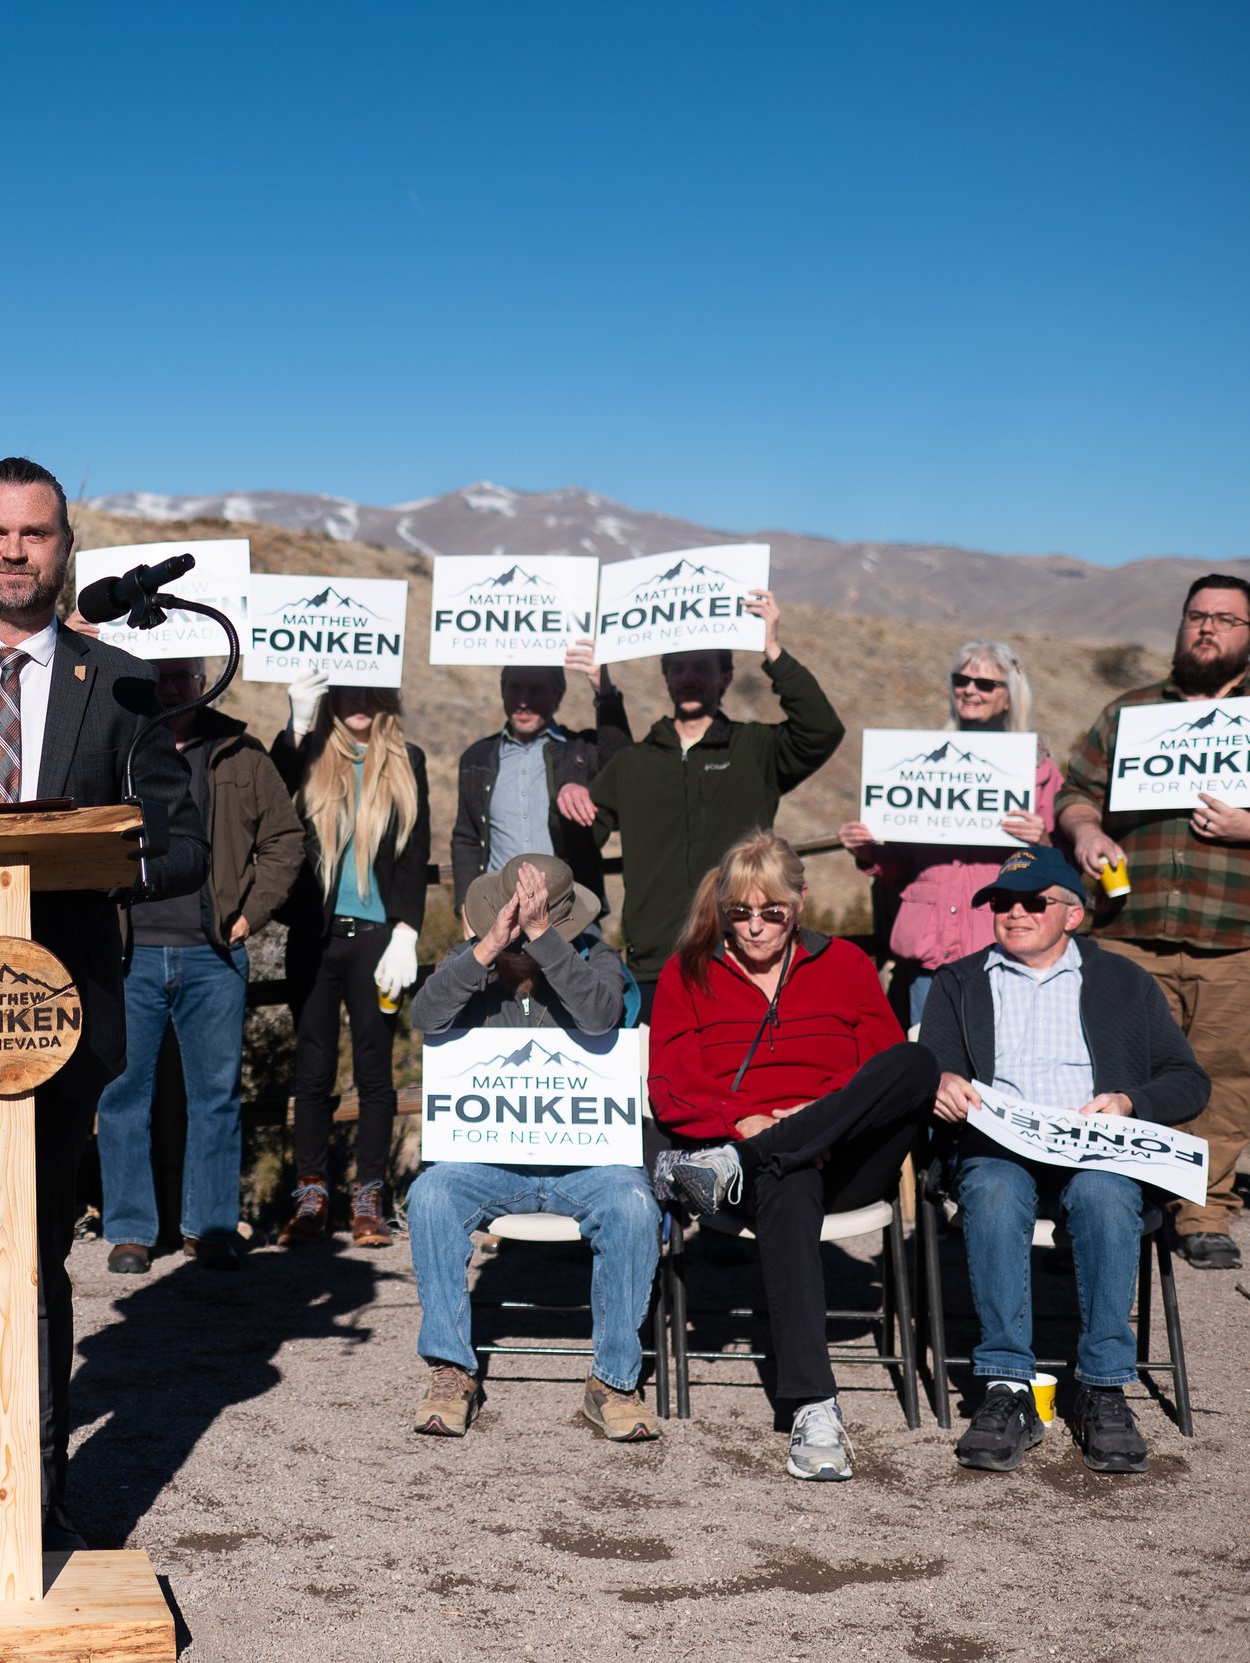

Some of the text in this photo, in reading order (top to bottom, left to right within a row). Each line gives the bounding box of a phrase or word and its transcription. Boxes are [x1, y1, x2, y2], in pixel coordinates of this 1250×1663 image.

[469, 594, 557, 606] MATTHEW
[635, 582, 726, 604] MATTHEW
[282, 614, 369, 627] MATTHEW
[435, 609, 592, 634] FONKEN
[252, 627, 400, 656] FONKEN
[617, 623, 739, 646] FOR NEVADA
[452, 638, 568, 650] FOR NEVADA
[266, 656, 380, 671] FOR NEVADA
[1160, 734, 1250, 751] MATTHE
[1117, 750, 1250, 779] FONK
[900, 770, 993, 784] MATTHEW
[1138, 781, 1180, 795] FOR
[865, 785, 1030, 812] FONKEN
[883, 814, 919, 826] FOR
[472, 1076, 588, 1090] MATTHEW
[426, 1094, 636, 1125] FONKEN
[452, 1129, 610, 1145] FOR NEVADA
[1122, 1126, 1174, 1142] FOR
